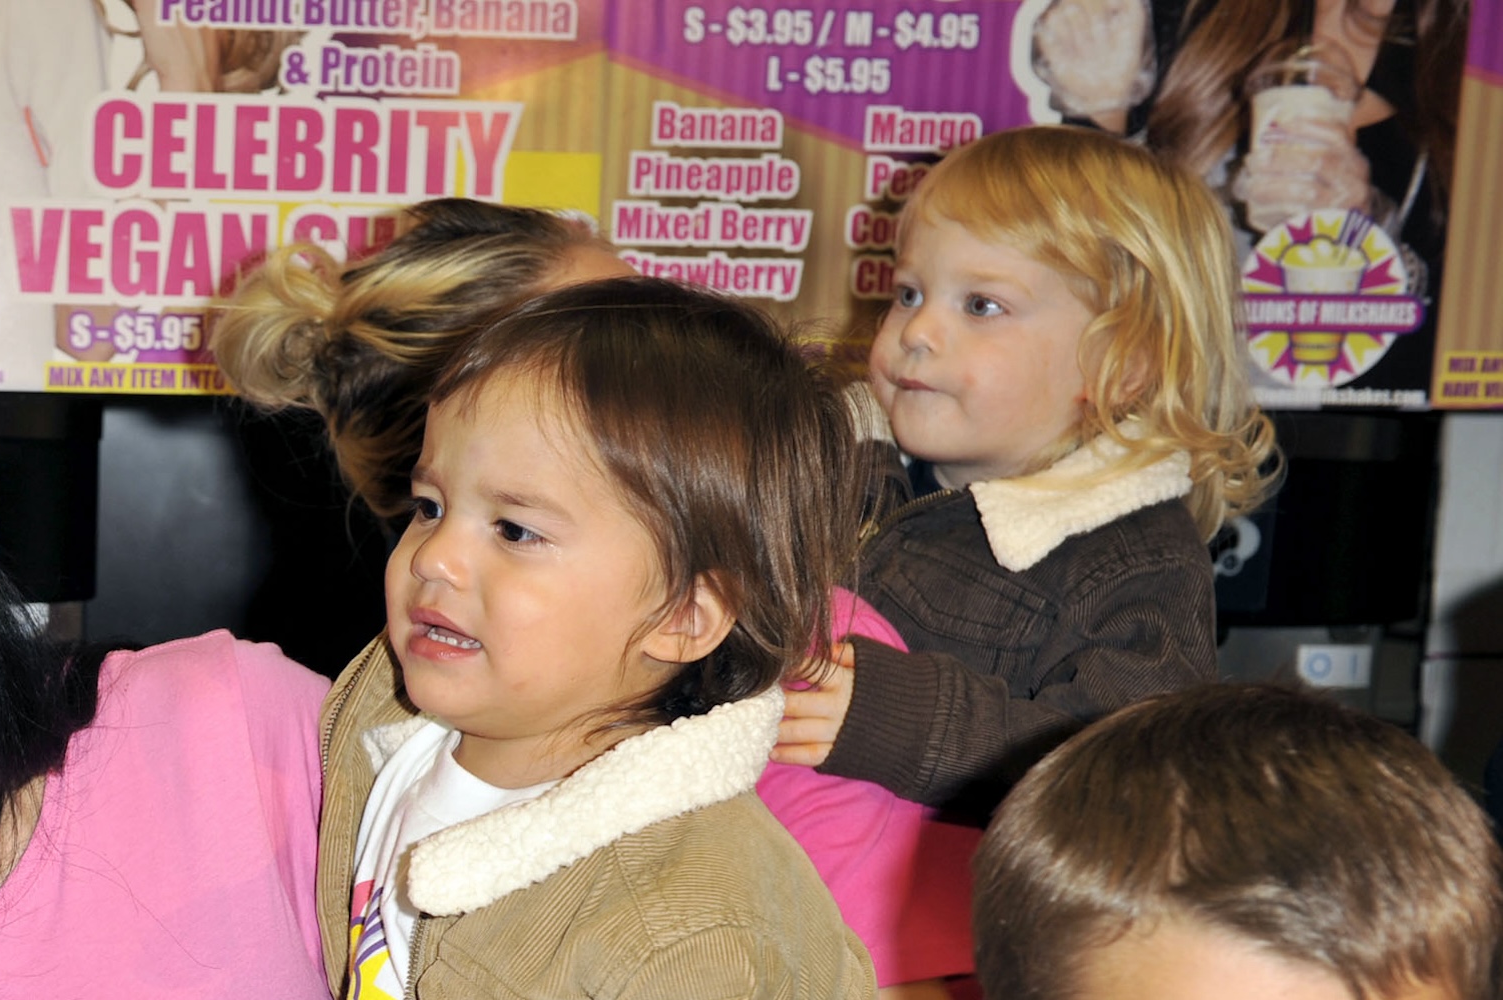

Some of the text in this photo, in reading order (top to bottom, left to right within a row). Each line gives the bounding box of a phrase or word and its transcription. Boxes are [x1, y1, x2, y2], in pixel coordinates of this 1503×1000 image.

[160, 0, 573, 39] Peanut Butter, Banana
[683, 7, 705, 43] S
[727, 5, 814, 46] $3.95
[844, 12, 874, 46] M
[893, 10, 980, 49] $4.95
[285, 47, 456, 89] & Protein
[766, 56, 781, 91] L
[803, 54, 891, 94] $5.95
[657, 107, 778, 143] Banana
[870, 111, 977, 150] Mango
[94, 99, 511, 197] CELEBRITY
[634, 157, 794, 195] Pineapple
[617, 206, 806, 246] Mixed Berry
[10, 207, 269, 297] VEGAN
[624, 255, 797, 295] trawberry
[70, 313, 92, 349] S
[113, 312, 201, 352] $5.95
[1298, 301, 1319, 325] OF
[1320, 302, 1417, 327] MILKSHAKES
[49, 366, 85, 387] MIX
[89, 367, 127, 388] ANY
[131, 369, 177, 389] ITEM
